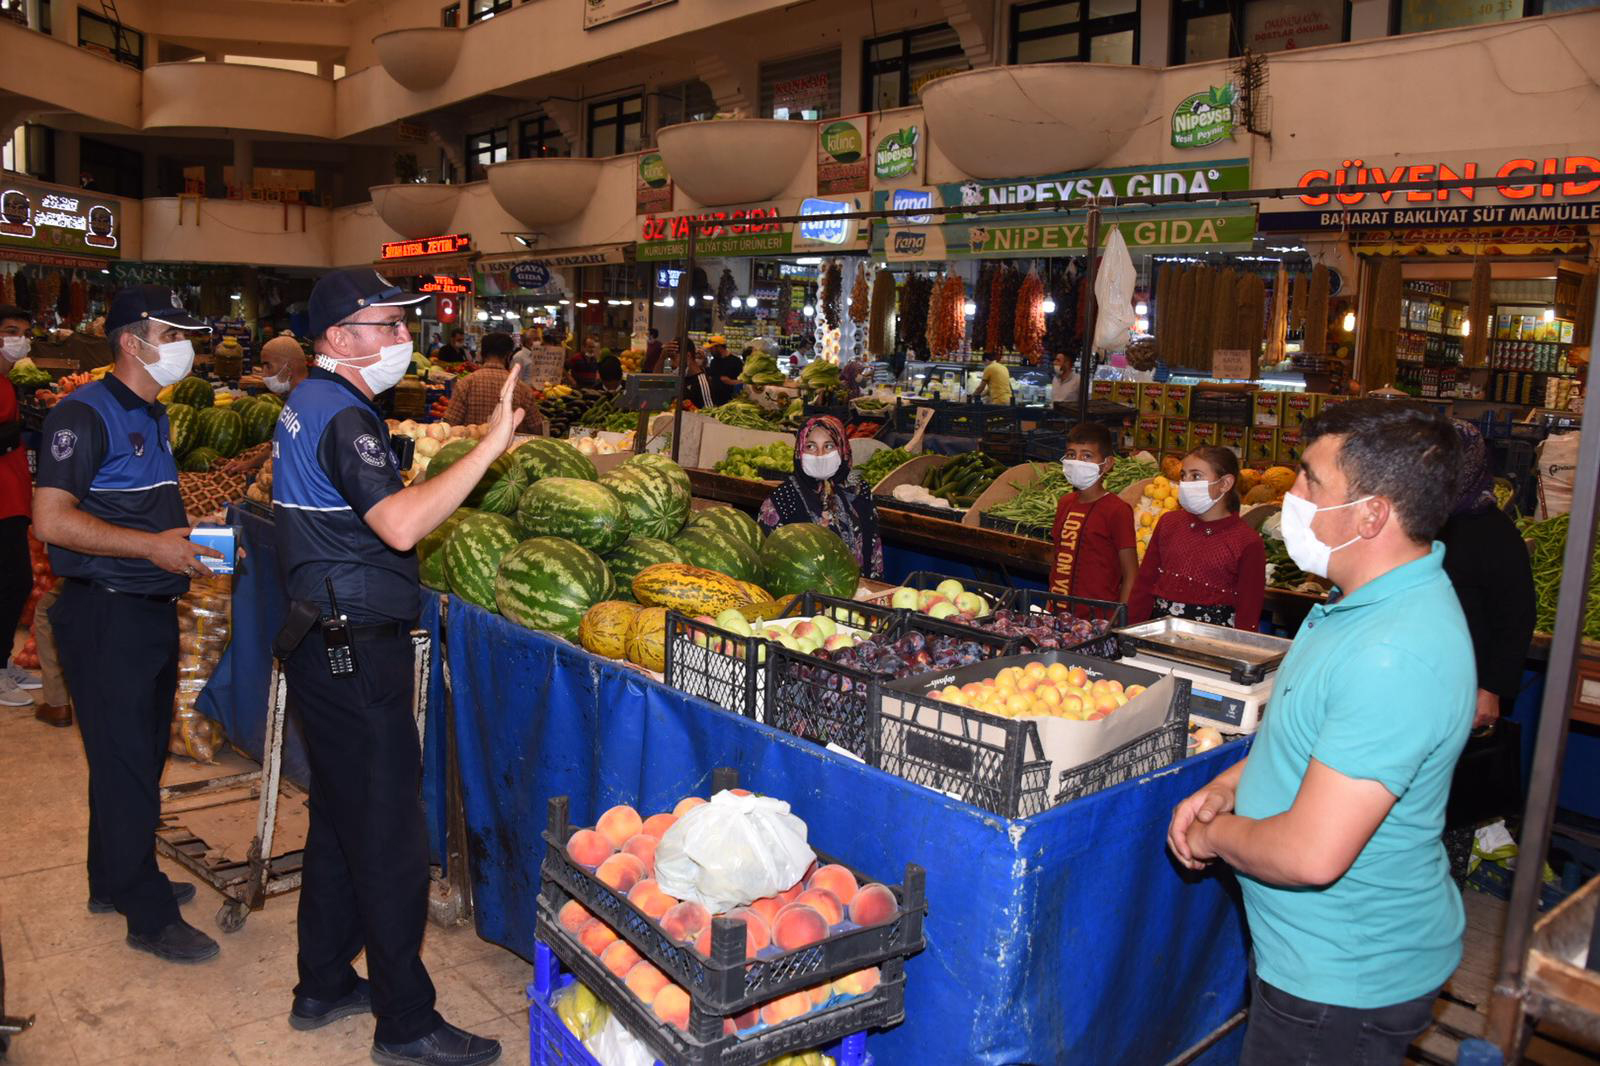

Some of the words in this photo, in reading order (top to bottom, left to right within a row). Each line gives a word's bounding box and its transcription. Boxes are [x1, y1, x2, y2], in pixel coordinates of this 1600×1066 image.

[1175, 107, 1231, 132] Nipeysa
[877, 147, 913, 166] Nipeysa
[1127, 170, 1210, 198] GIDA
[1297, 160, 1477, 206] GÜVEN
[643, 214, 666, 241] ÖZ
[731, 207, 781, 233] GIDA
[1320, 211, 1389, 226] BAHARAT
[1394, 207, 1468, 225] BAKLİYAT
[1473, 205, 1505, 222] SÜT
[895, 235, 925, 249] rana
[1134, 219, 1219, 246] GIDA
[515, 264, 545, 275] KAYA
[517, 273, 543, 281] GIDA
[1060, 511, 1085, 551] LOST
[1056, 552, 1073, 576] ON
[1051, 579, 1070, 609] YO
